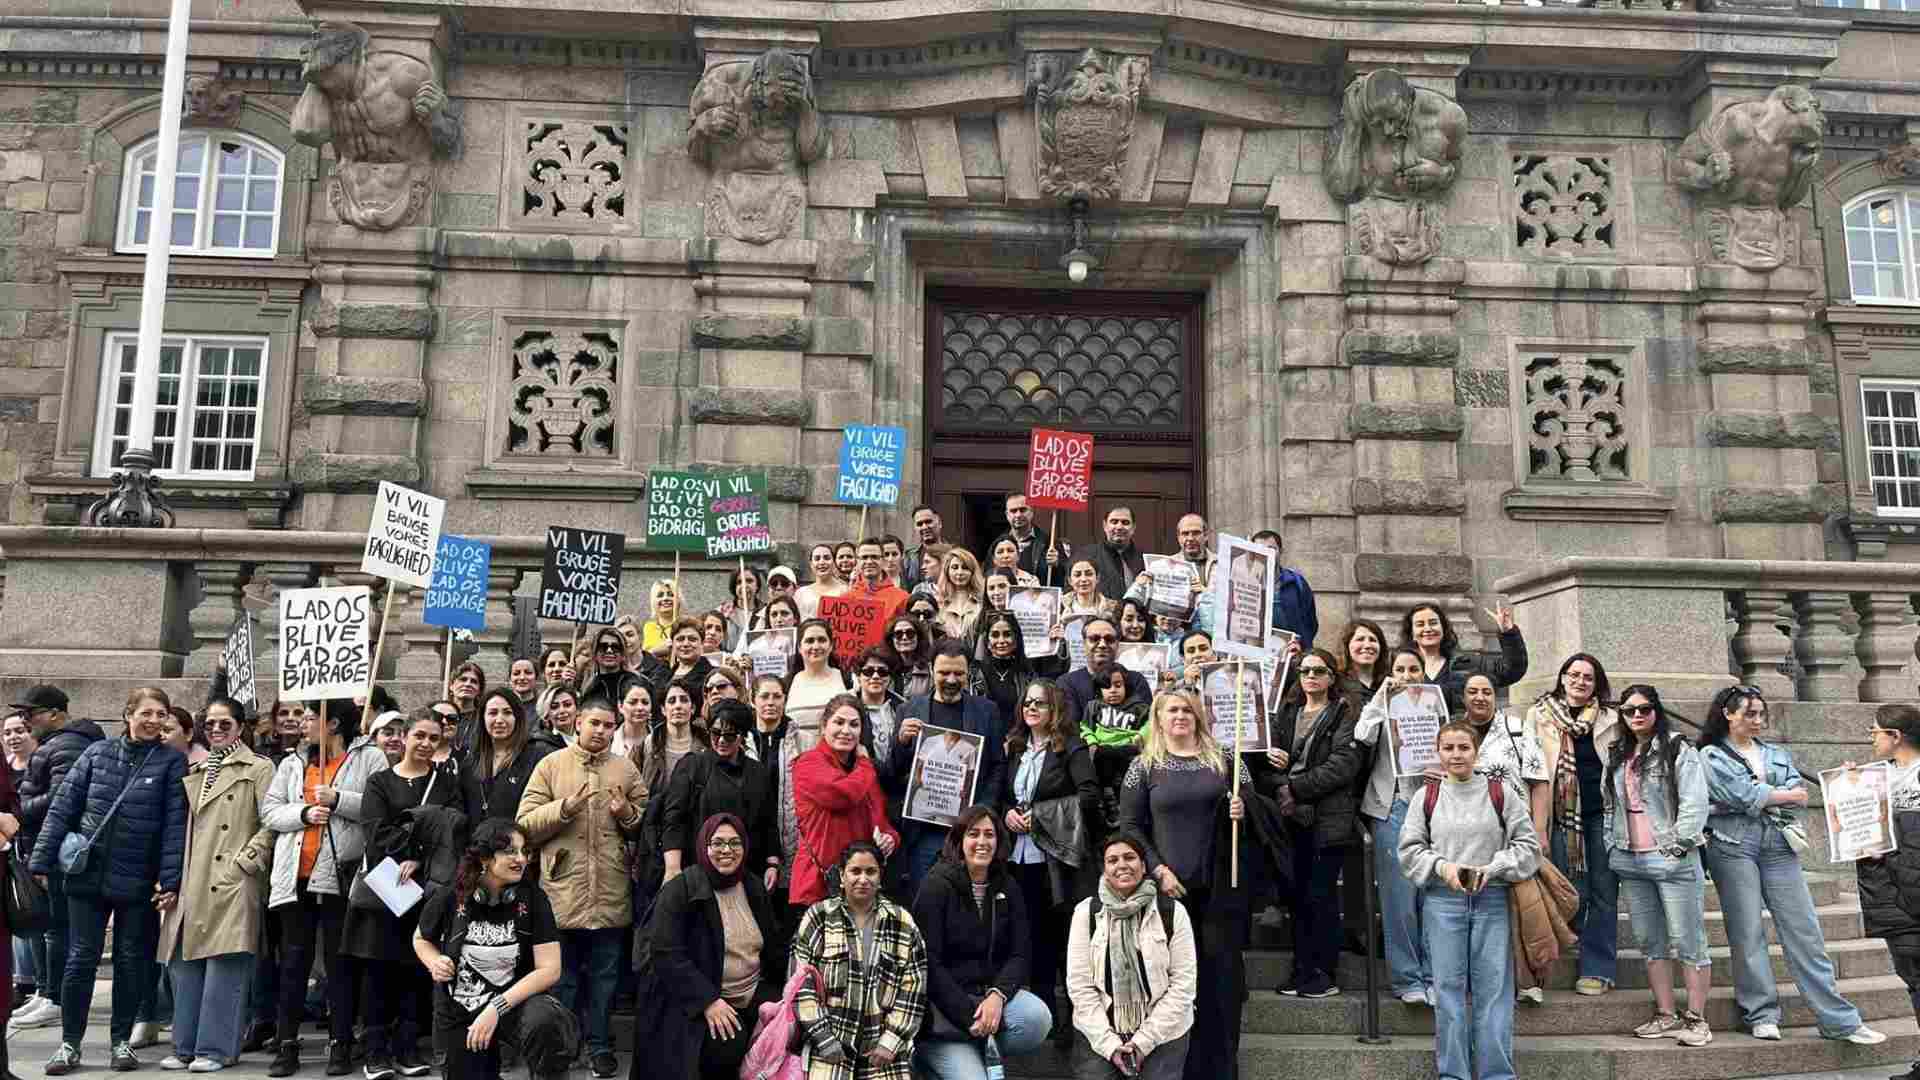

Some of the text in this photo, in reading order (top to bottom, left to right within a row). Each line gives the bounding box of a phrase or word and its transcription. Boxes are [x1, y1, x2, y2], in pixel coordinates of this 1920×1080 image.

[845, 428, 899, 448] VI VIL
[1034, 434, 1091, 458] LAD OS
[850, 446, 896, 463] BRUGE
[1033, 453, 1086, 473] BLIVE
[851, 460, 895, 479] VORES
[1031, 470, 1085, 487] LAD OS
[651, 475, 679, 489] LAD
[703, 475, 752, 498] VI VIL
[1030, 481, 1089, 503] BIDRAGE
[385, 488, 430, 518] VI VIL
[650, 503, 681, 518] LAD
[387, 510, 429, 537] BRUGE
[716, 512, 760, 532] BRUGE
[385, 525, 429, 550] VORES
[549, 530, 611, 554] VI VIL
[368, 537, 430, 576] FAGLIGHED
[462, 546, 484, 563] OS
[556, 549, 611, 573] BRUGE
[461, 580, 481, 593] OS
[558, 569, 617, 597] VORES
[286, 594, 366, 623] LAD OS
[426, 590, 486, 613] BIDRAGE
[542, 589, 616, 622] FAGLIGHED
[822, 599, 874, 620] LAD OS
[286, 623, 360, 653] BLIVE
[285, 644, 363, 668] LAD OS
[283, 663, 368, 690] BIDRAGE
[1101, 706, 1135, 730] NYC
